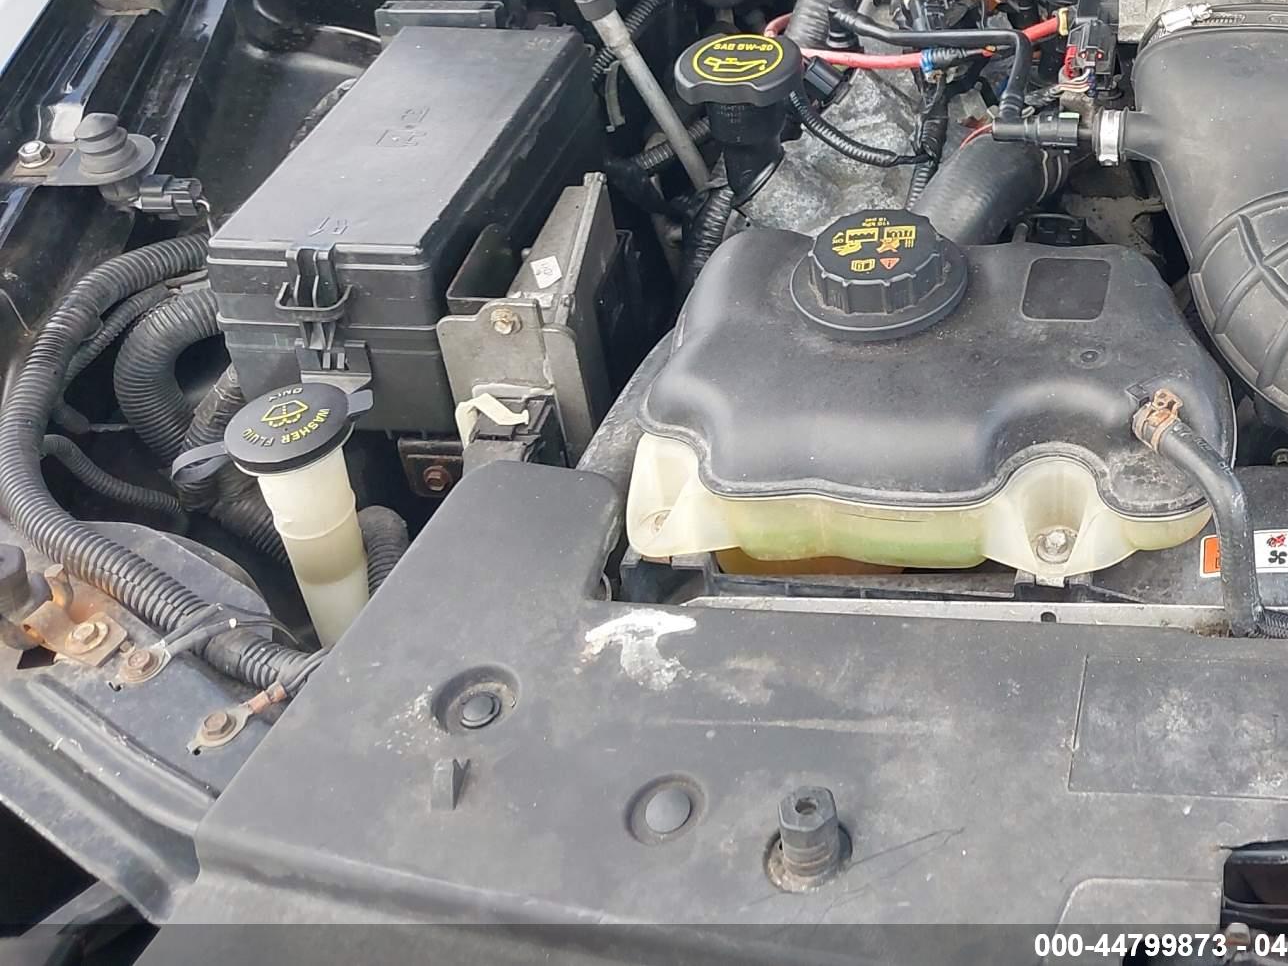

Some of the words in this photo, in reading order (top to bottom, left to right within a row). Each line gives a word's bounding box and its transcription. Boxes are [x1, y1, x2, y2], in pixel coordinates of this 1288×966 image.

[713, 43, 735, 52] SAE
[736, 43, 774, 52] 5W-20
[268, 387, 303, 402] ONLY
[281, 408, 331, 445] WASHER
[242, 428, 276, 447] FLUID
